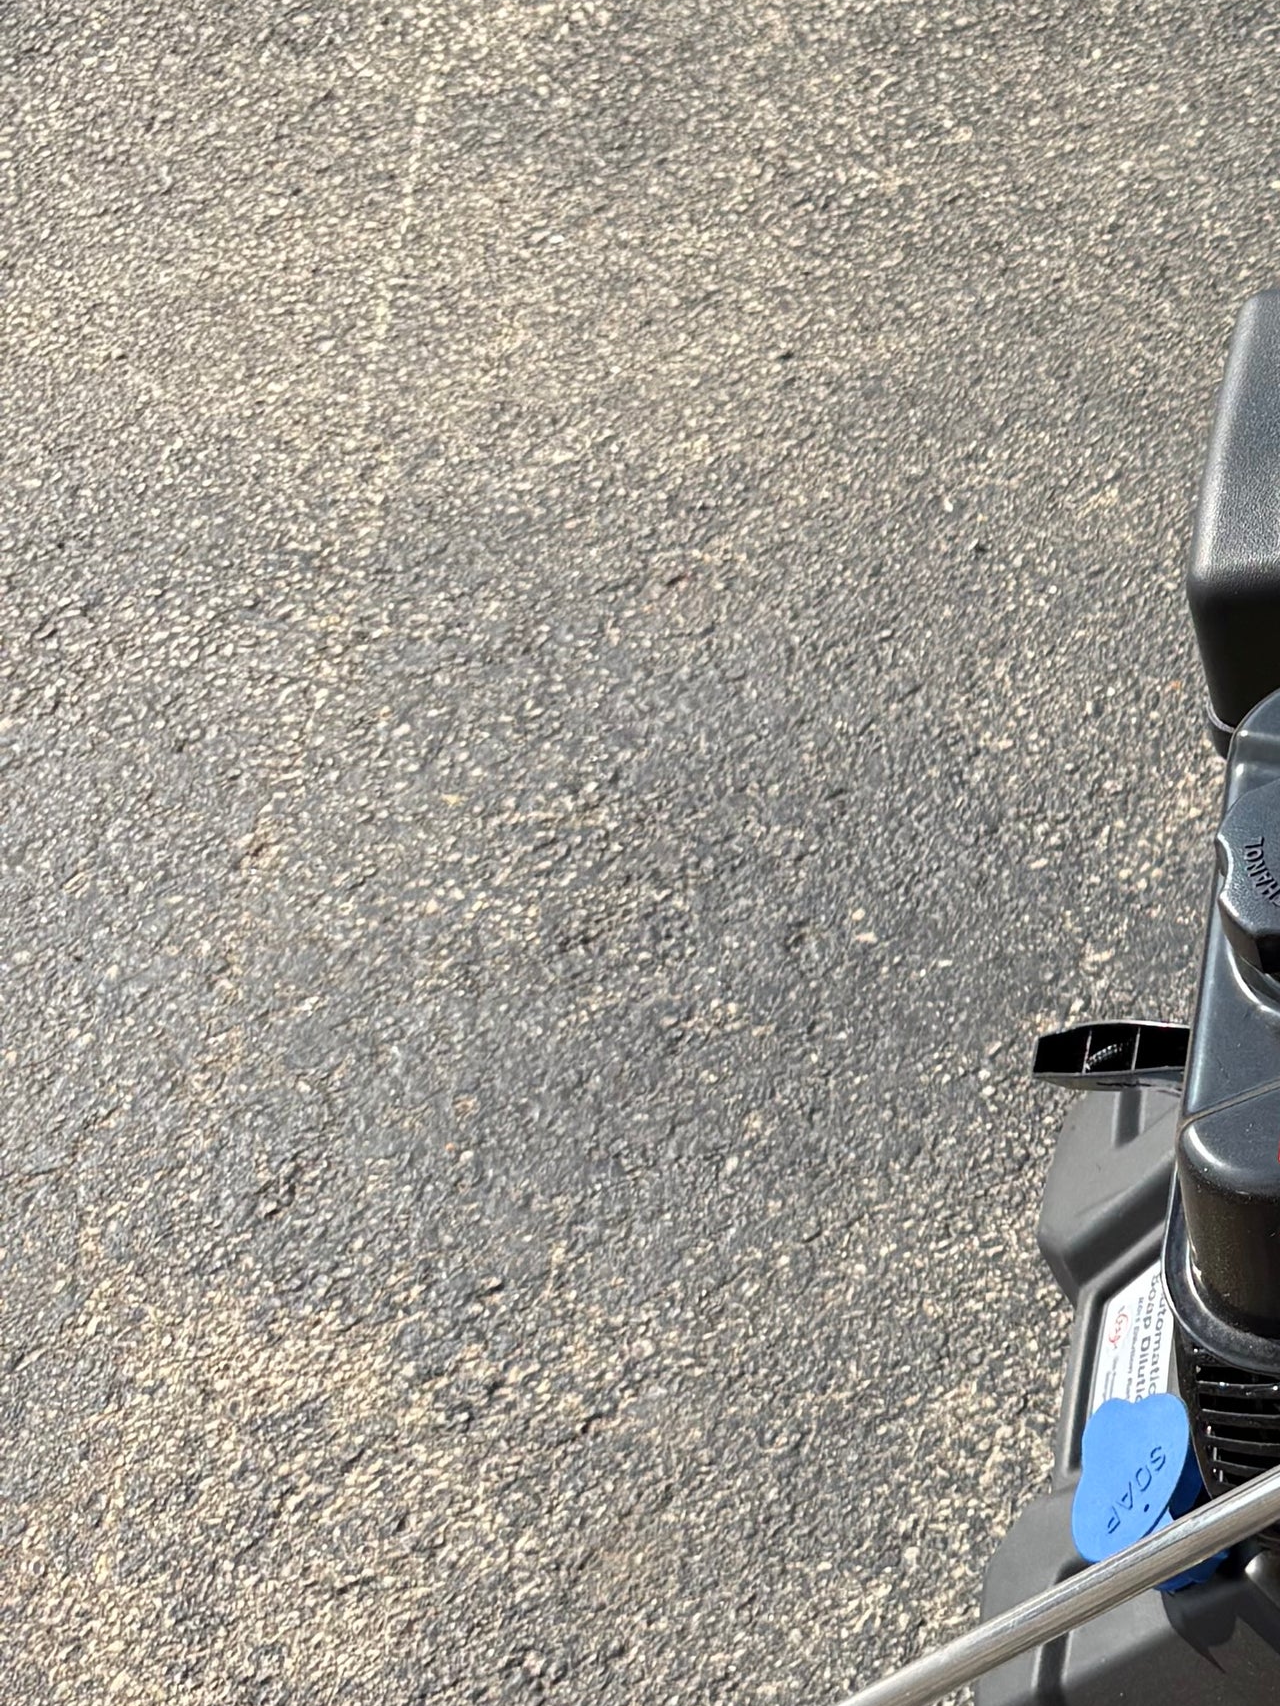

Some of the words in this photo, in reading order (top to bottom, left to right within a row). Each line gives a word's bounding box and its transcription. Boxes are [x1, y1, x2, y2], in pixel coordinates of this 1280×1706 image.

[1135, 1337, 1150, 1404] Dilutio
[1148, 1294, 1167, 1395] utomatic
[1107, 1446, 1166, 1534] SOAP
